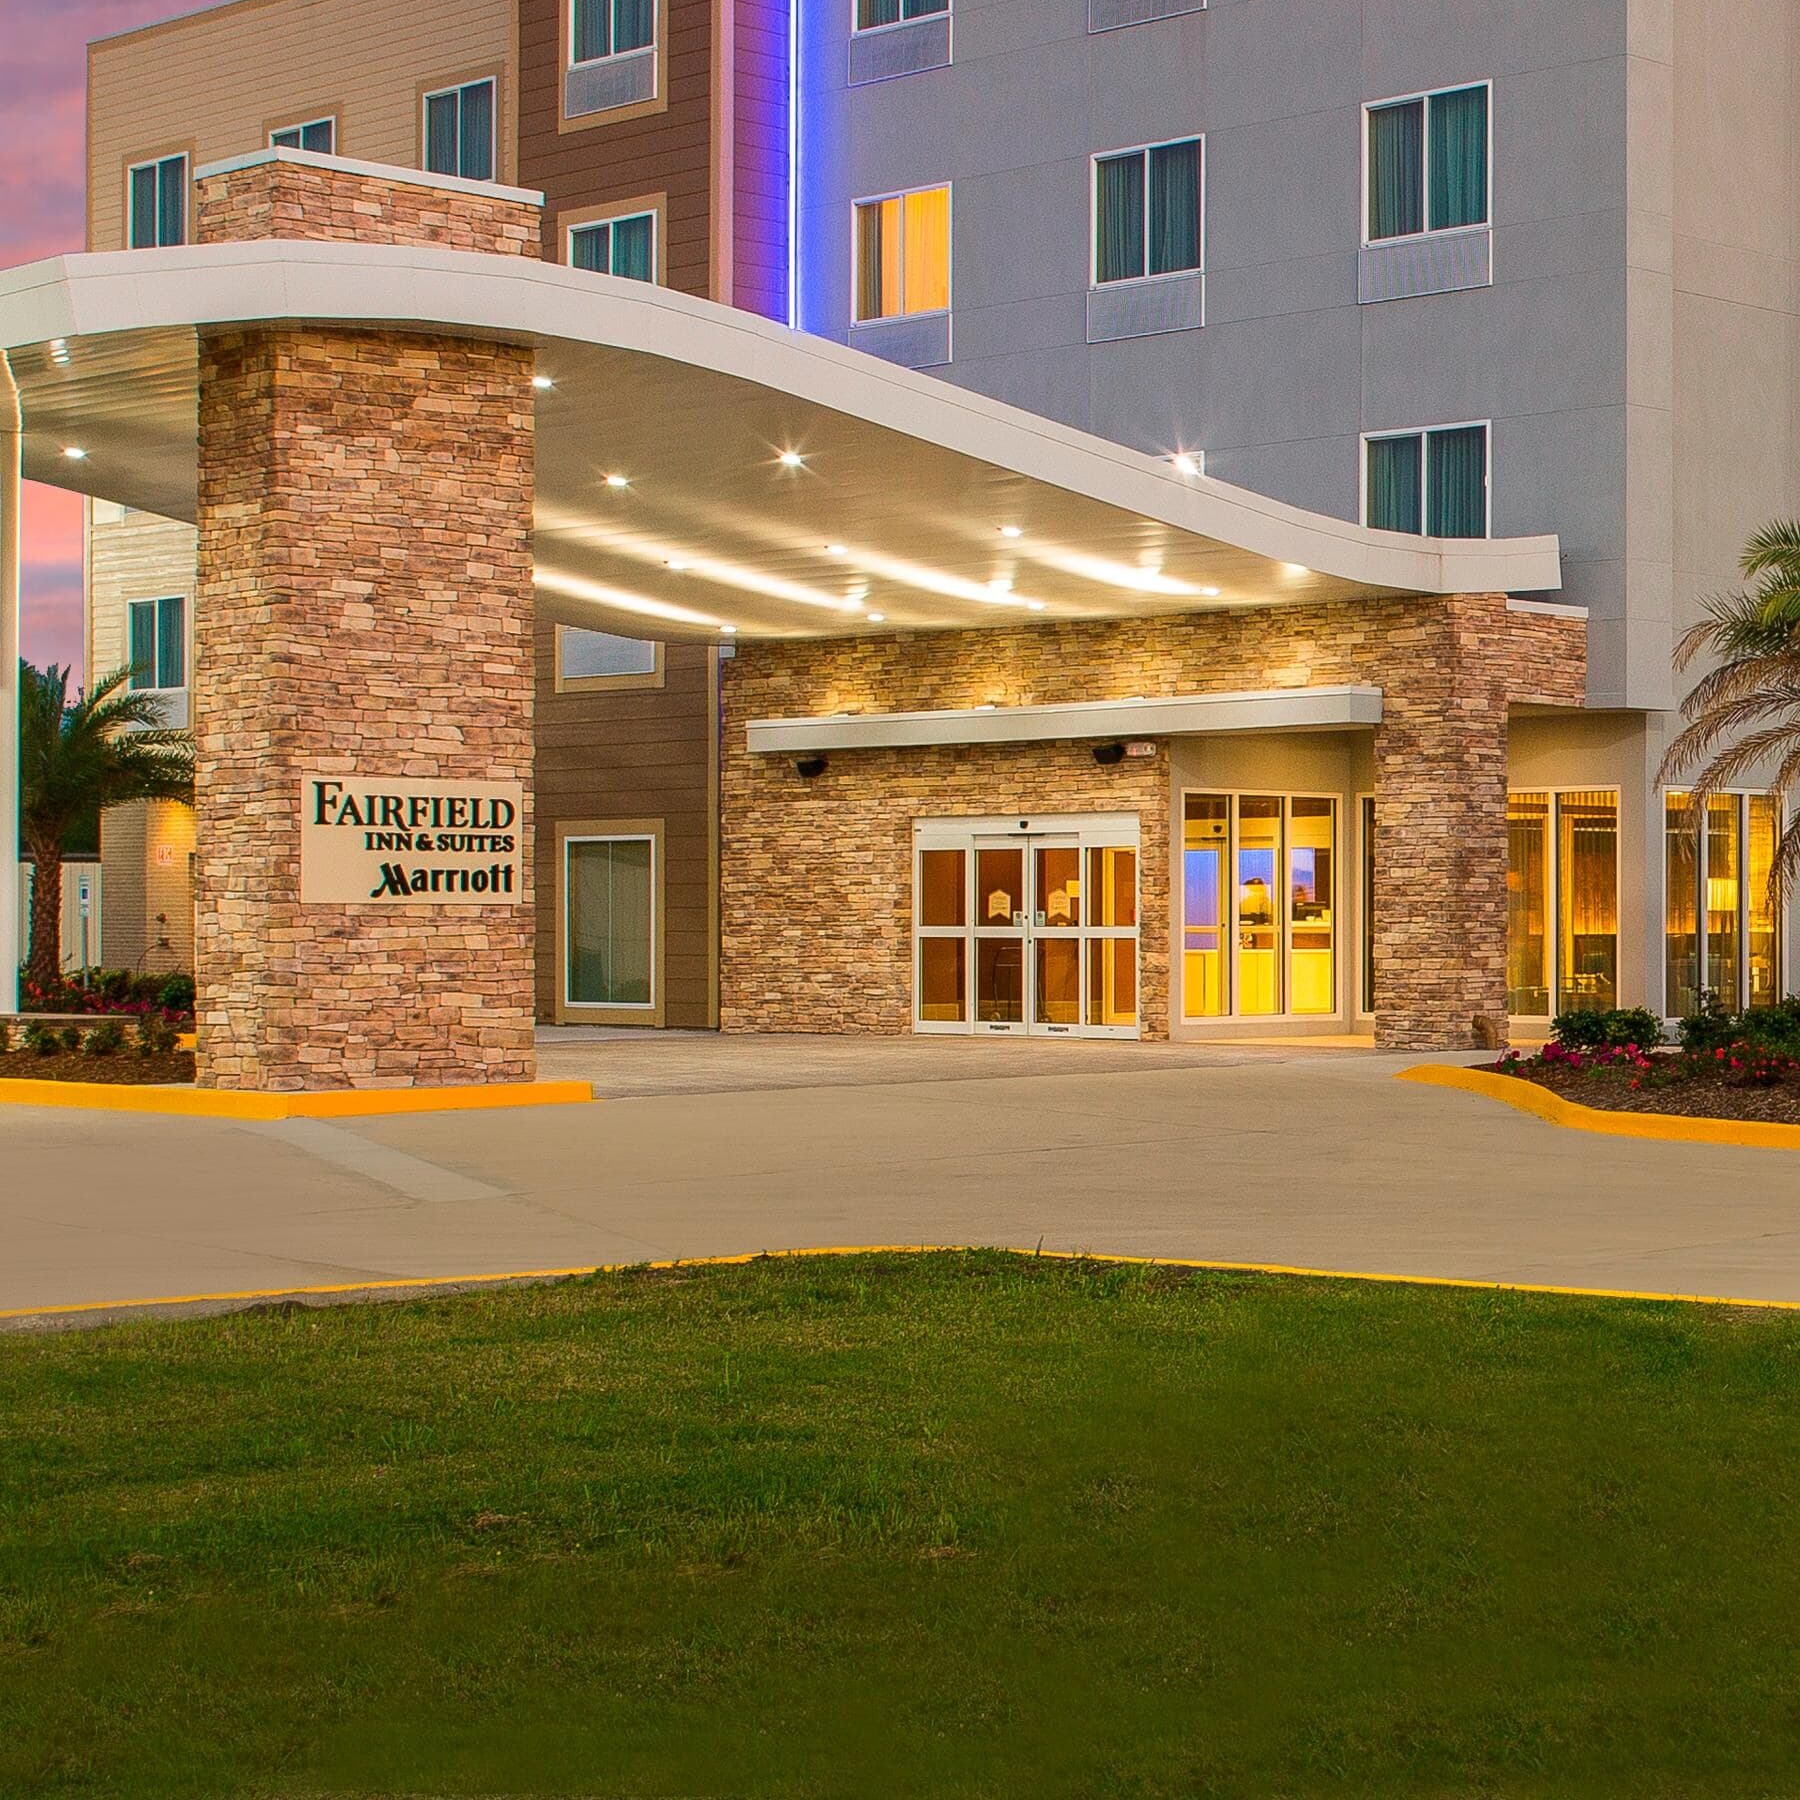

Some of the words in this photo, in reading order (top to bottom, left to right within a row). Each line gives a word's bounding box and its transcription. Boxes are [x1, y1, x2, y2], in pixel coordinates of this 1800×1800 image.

[312, 781, 516, 831] FAIRFIELD
[437, 834, 515, 853] SUITES
[370, 862, 515, 898] Marriott
